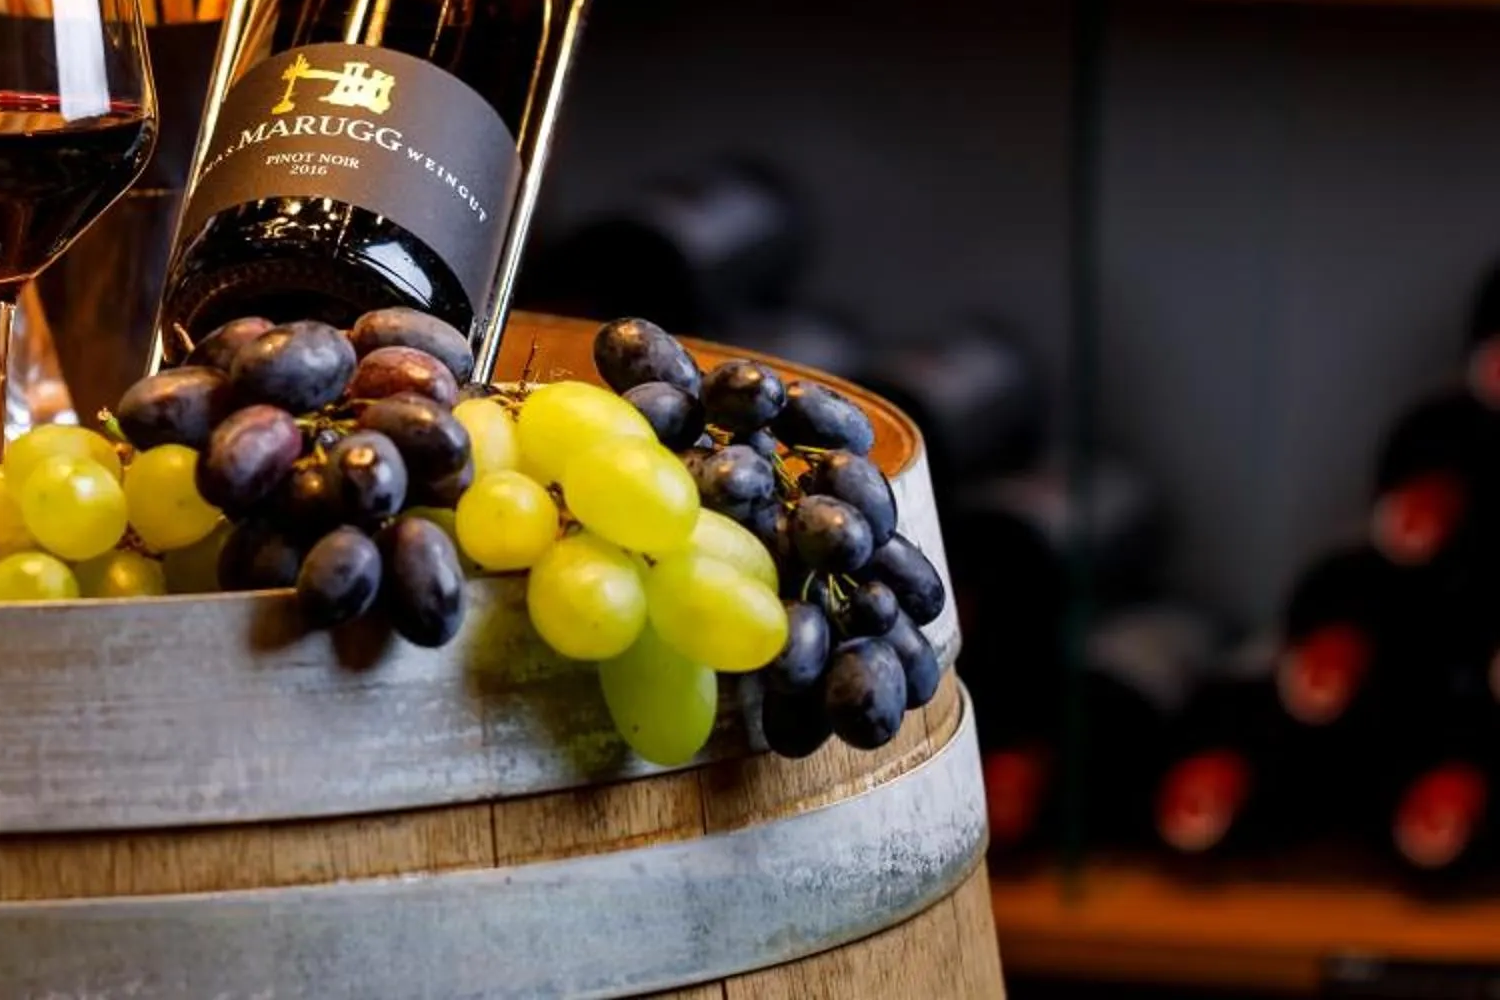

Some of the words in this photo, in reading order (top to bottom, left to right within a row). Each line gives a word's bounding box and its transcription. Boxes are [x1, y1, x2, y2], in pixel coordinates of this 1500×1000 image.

[237, 115, 402, 151] MARUGG
[407, 147, 487, 222] WEINGUT
[266, 153, 314, 166] PINOT
[318, 153, 359, 169] NOIR
[289, 163, 328, 175] 2016
